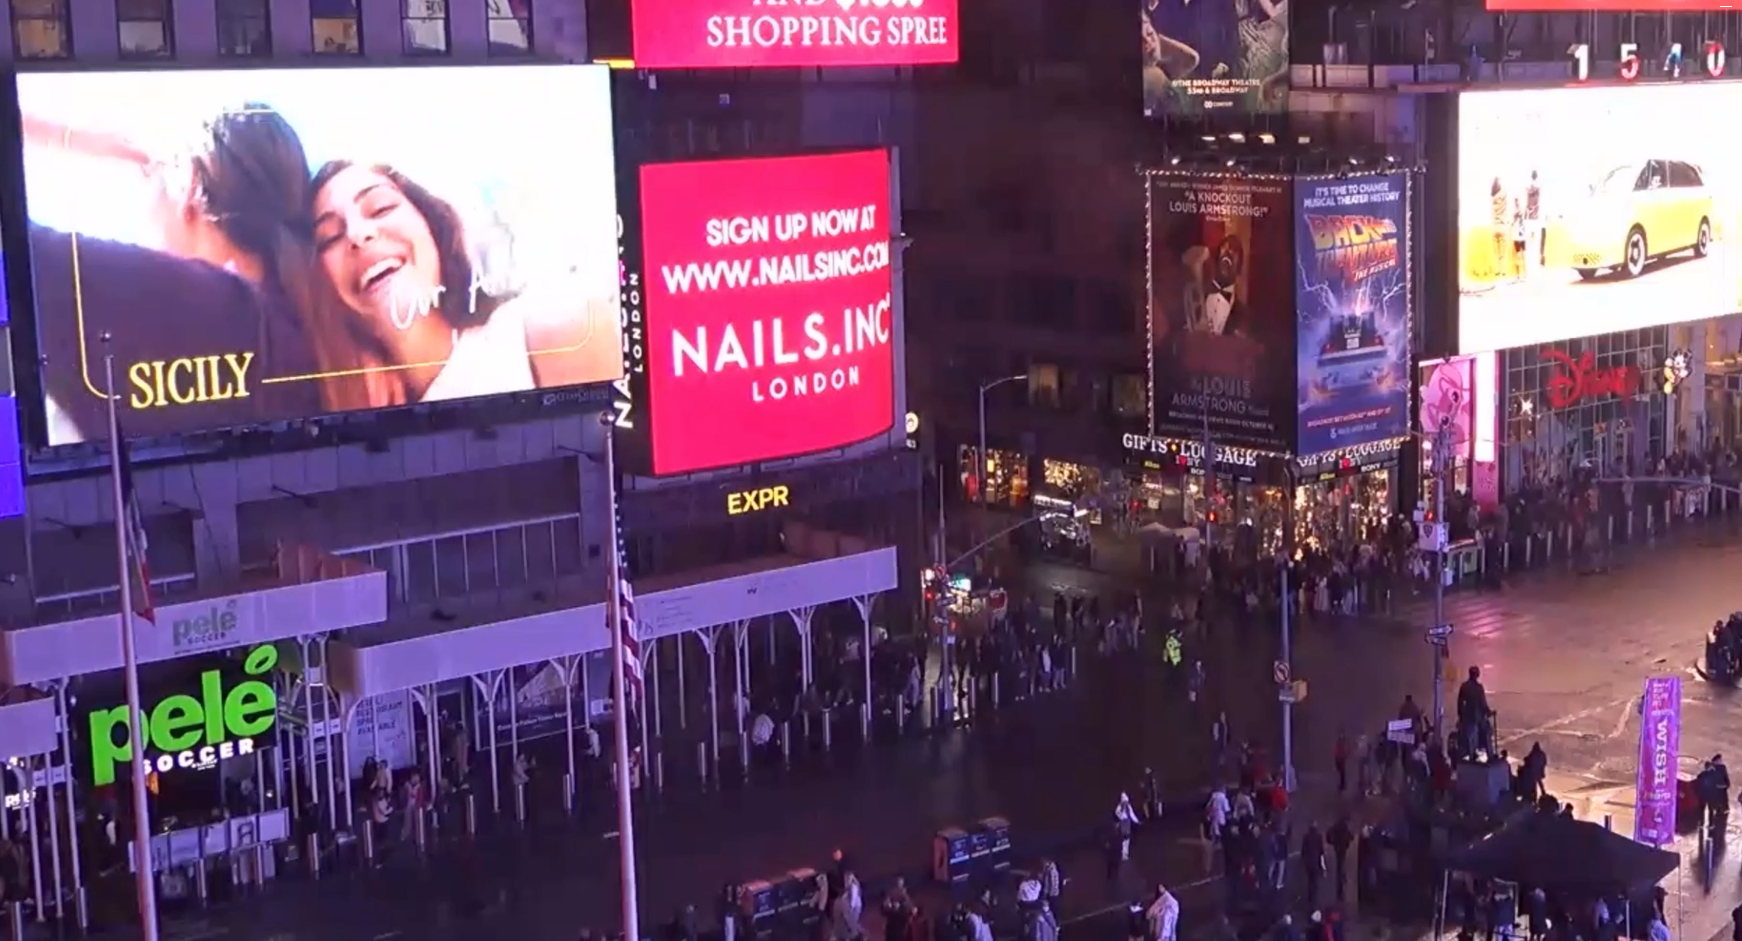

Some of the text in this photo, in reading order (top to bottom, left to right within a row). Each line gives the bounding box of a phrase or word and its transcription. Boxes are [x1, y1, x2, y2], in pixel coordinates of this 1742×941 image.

[707, 15, 947, 47] SHOPPING SPREE
[1193, 79, 1230, 88] BROADWAY
[1212, 86, 1249, 95] BROADWAY
[1198, 192, 1251, 204] KNOCKOUT
[1337, 194, 1369, 206] THEATER
[1370, 191, 1400, 202] HISTORY
[1349, 184, 1359, 194] TO
[1360, 182, 1389, 193] CHANGE
[1169, 202, 1197, 214] LOUIS
[706, 204, 876, 247] SIGN UP NOW AT
[629, 273, 644, 372] LONDON
[672, 297, 890, 377] NAILS.INC
[129, 352, 255, 409] SICILY
[752, 366, 859, 402] LONDON
[1172, 393, 1246, 414] ARMSTRONG
[1122, 433, 1168, 453] GIFTS
[727, 485, 789, 515] EXPR
[173, 600, 237, 646] pelé
[89, 644, 278, 786] pelé
[142, 738, 254, 774] SOCCER
[1654, 718, 1667, 785] WISH
